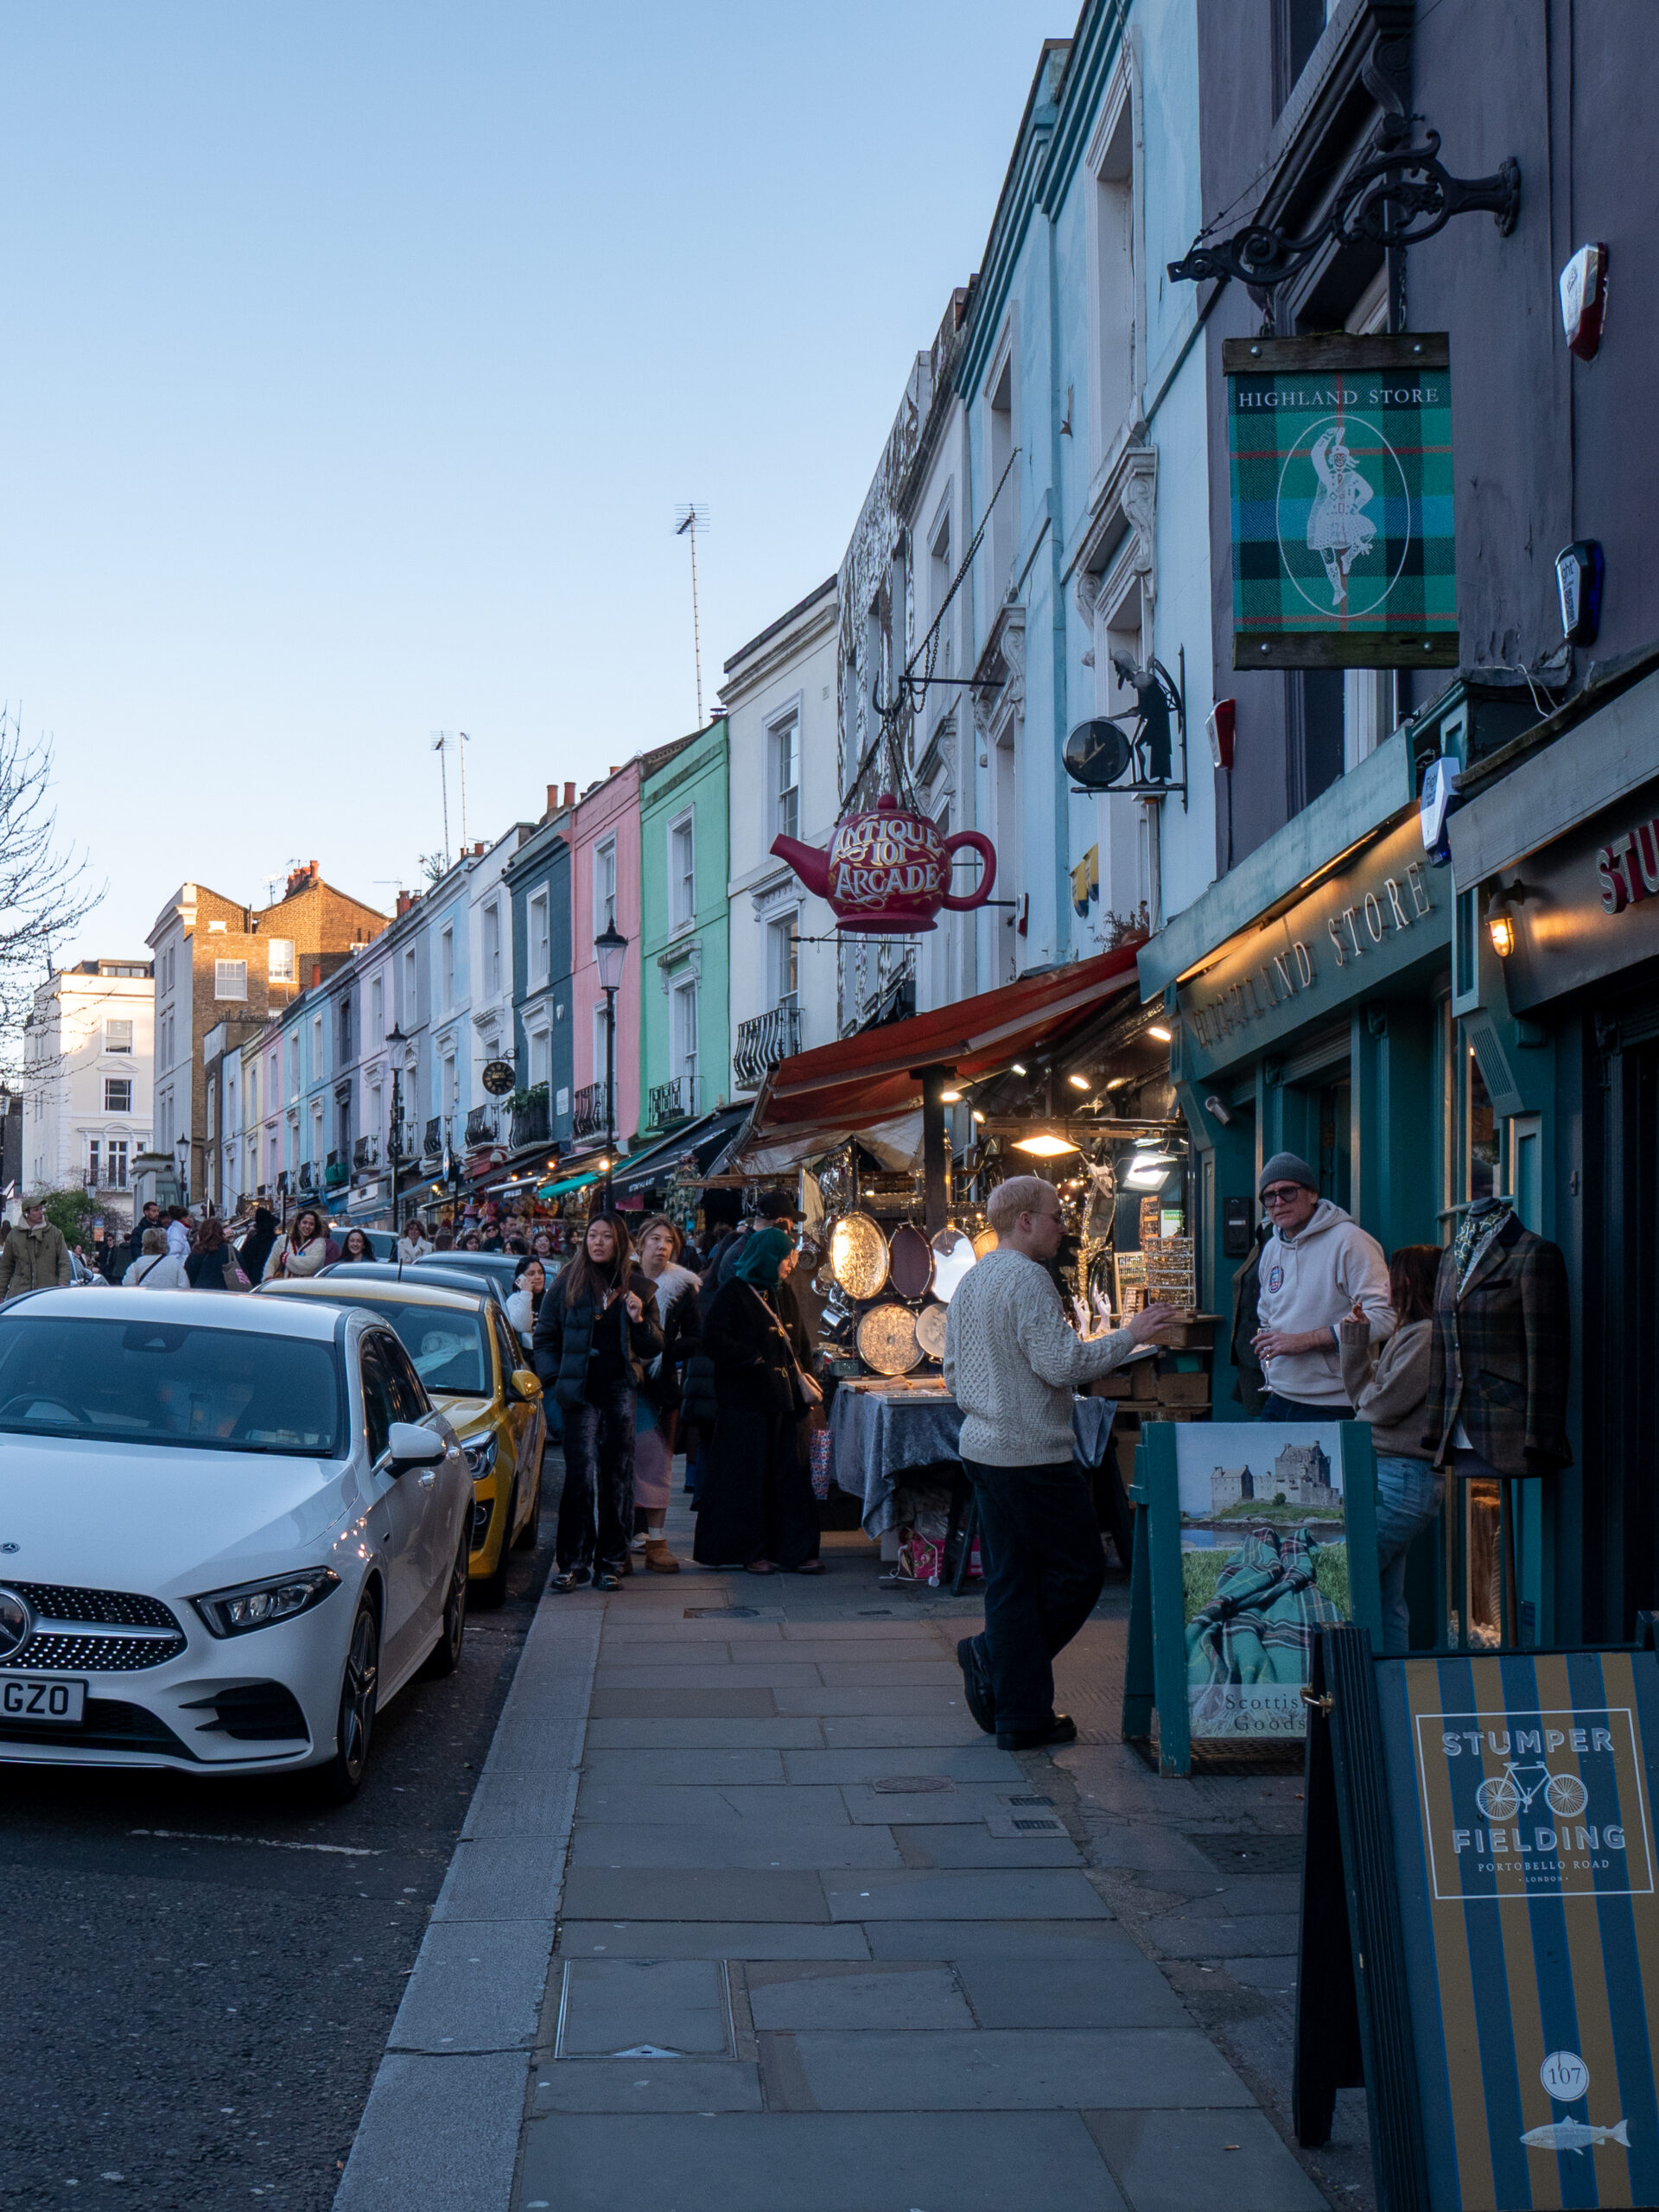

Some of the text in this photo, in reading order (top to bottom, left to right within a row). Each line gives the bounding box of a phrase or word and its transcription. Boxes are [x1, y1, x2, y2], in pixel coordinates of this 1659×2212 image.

[1239, 387, 1440, 407] HIGHLAND STORE
[830, 818, 946, 869] ANTIQUE
[834, 861, 945, 907] ARCADE
[1328, 861, 1430, 967] STORE
[4, 1682, 68, 1715] GZO
[1234, 1714, 1306, 1731] Goods
[1441, 1727, 1615, 1756] STUMPER
[1452, 1825, 1626, 1853] FIELDING
[1478, 1859, 1611, 1872] PORTOBELLO ROAD
[1548, 2067, 1581, 2085] 107
